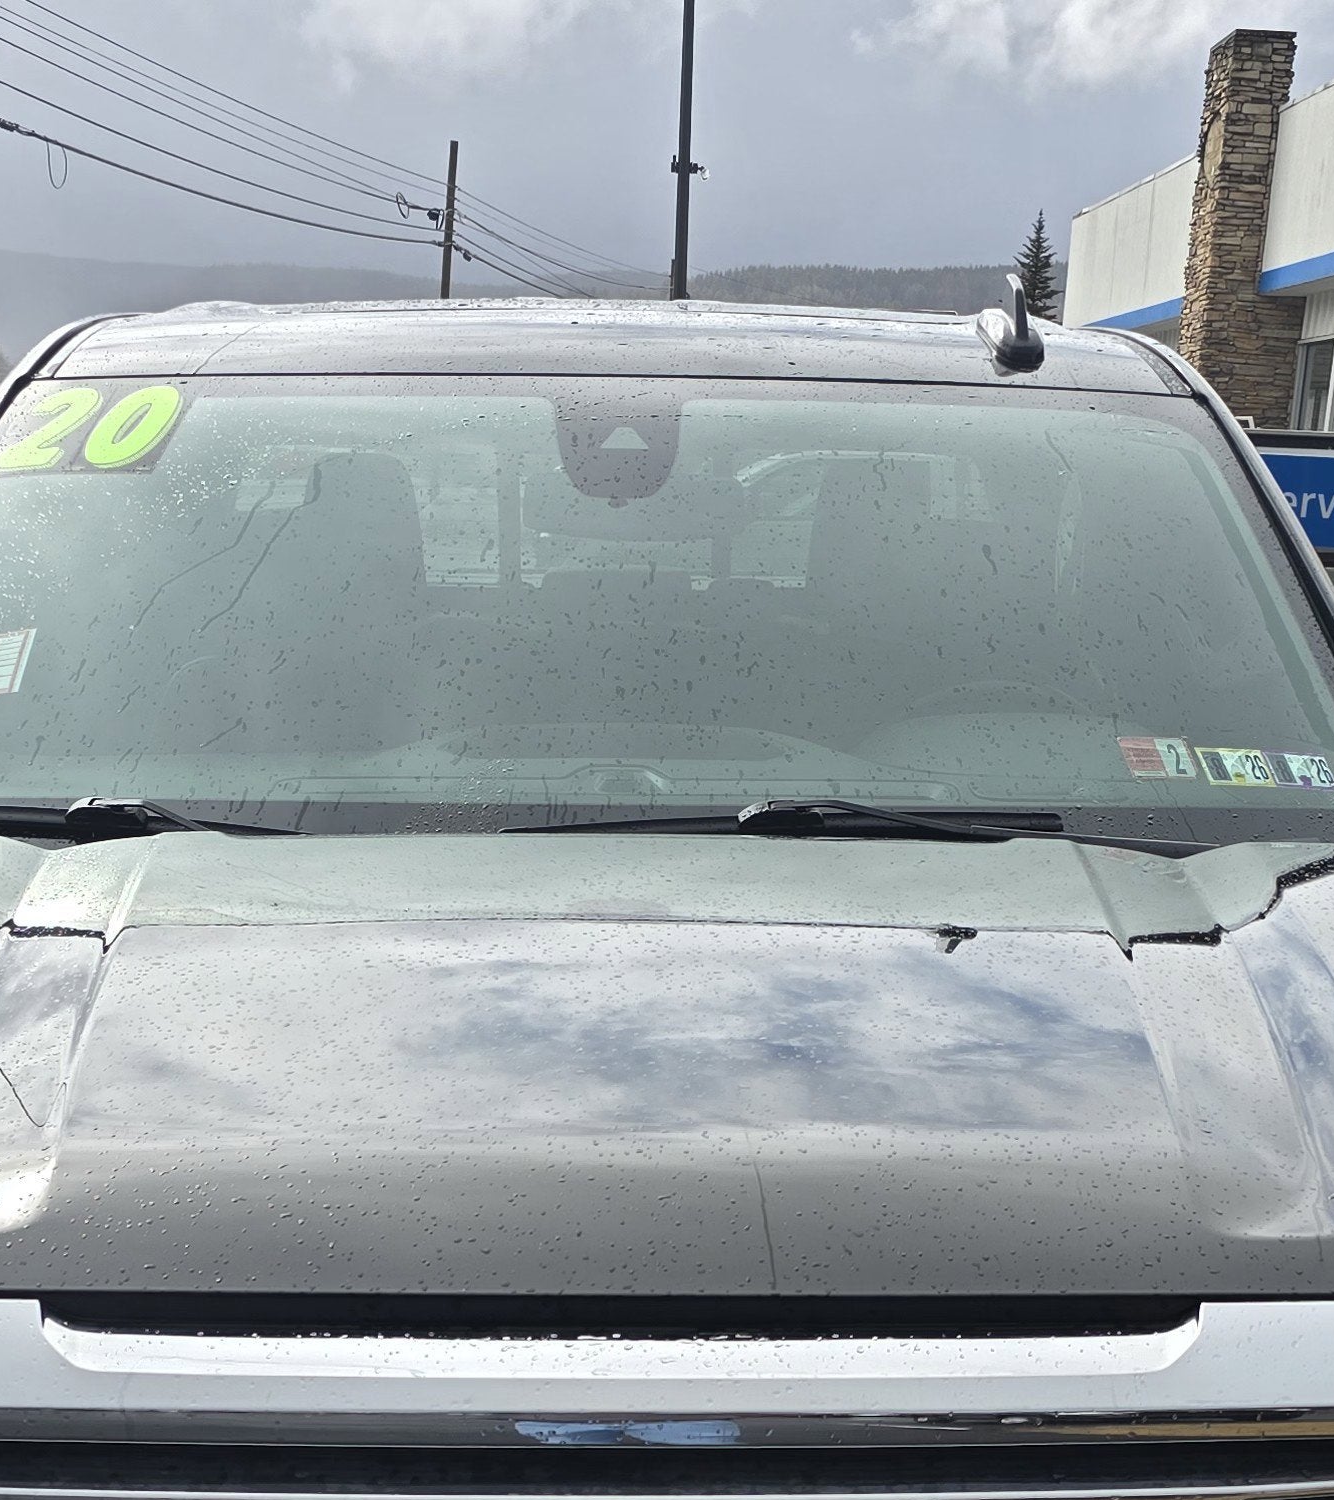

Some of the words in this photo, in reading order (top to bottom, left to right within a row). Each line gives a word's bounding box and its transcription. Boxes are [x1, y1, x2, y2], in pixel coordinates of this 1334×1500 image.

[1167, 744, 1188, 775] 2
[1245, 755, 1270, 780] 26
[1310, 758, 1334, 784] 26
